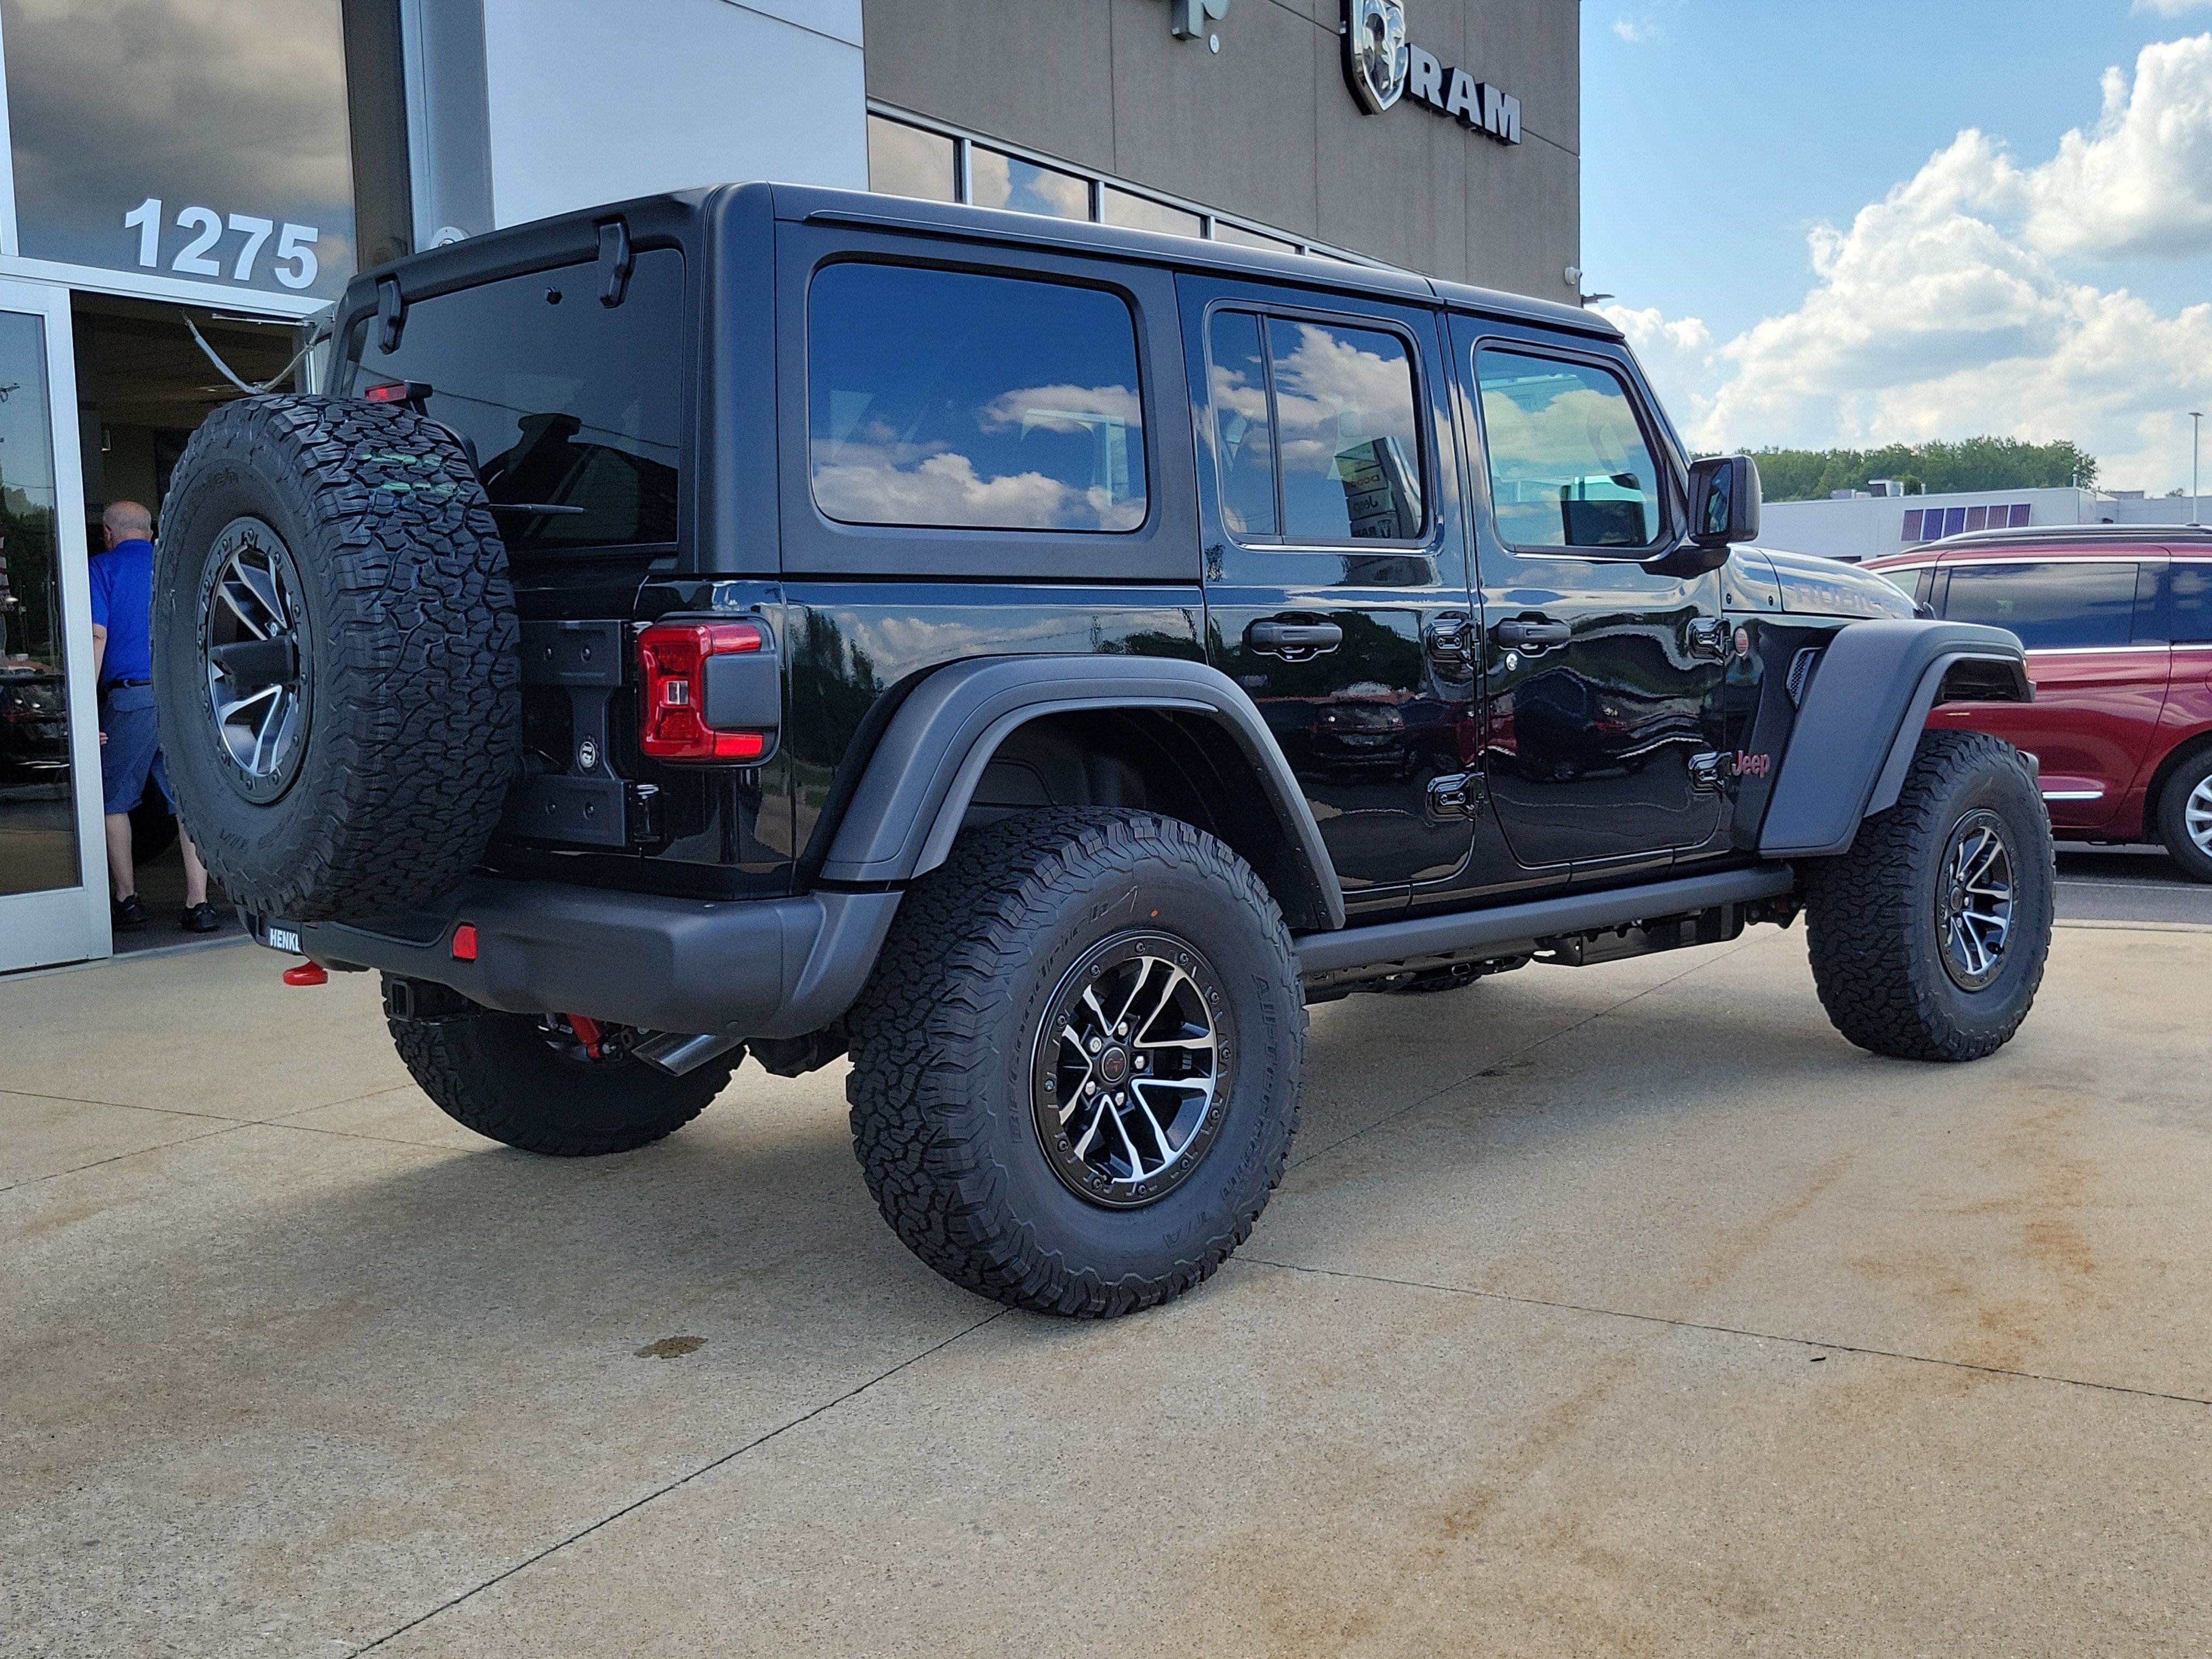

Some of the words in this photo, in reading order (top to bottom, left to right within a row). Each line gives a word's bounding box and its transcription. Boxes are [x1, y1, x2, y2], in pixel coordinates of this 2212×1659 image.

[1408, 43, 1522, 145] RAM
[124, 198, 319, 290] 1275
[1793, 582, 1906, 616] RUBIC
[1731, 749, 1770, 779] Jeep
